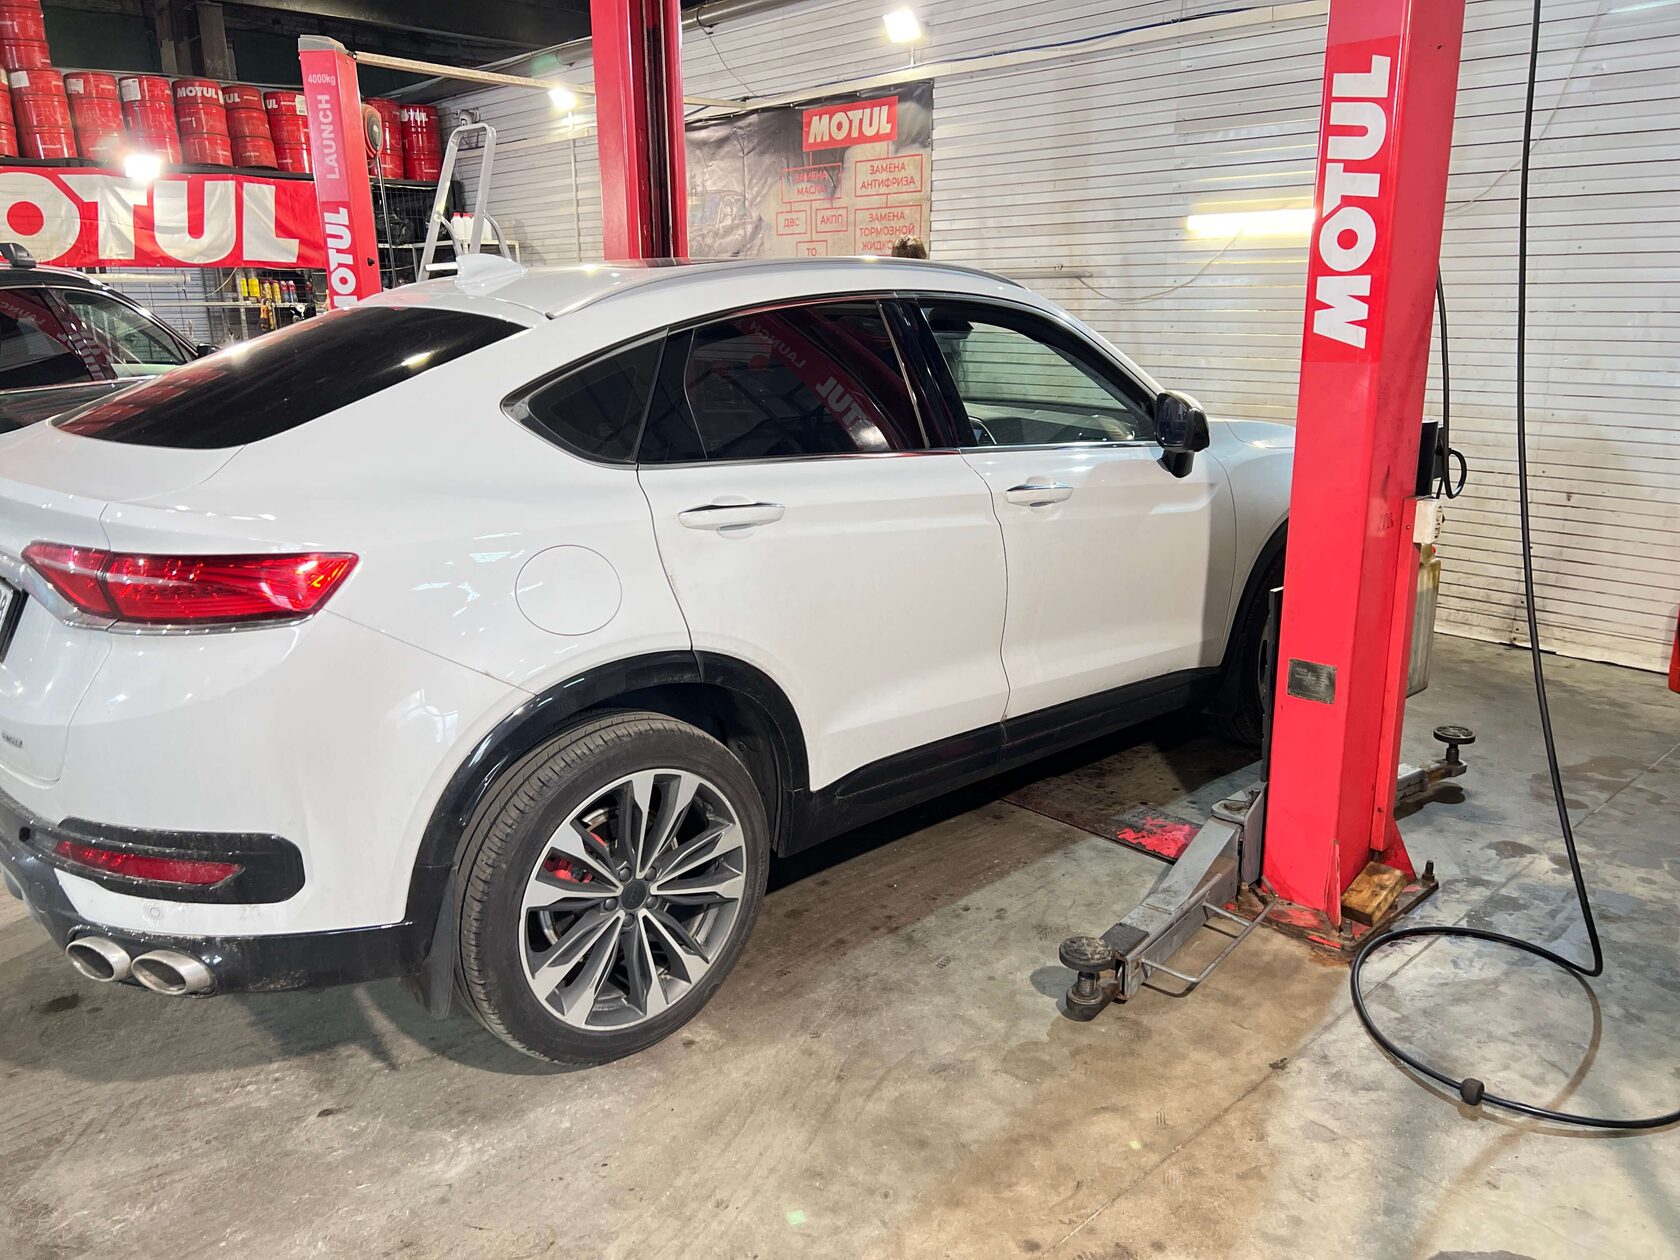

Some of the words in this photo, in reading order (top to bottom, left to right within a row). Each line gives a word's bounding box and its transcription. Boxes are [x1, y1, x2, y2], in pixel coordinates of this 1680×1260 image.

[307, 74, 336, 86] 4000kg
[176, 86, 217, 99] MOTUL
[807, 105, 892, 144] MOTUL
[316, 95, 340, 179] LAUNCH
[869, 162, 906, 175] ЗАМЕНА
[795, 170, 828, 183] ЗАМЕНА
[860, 176, 916, 190] АНТИФРИЗА
[796, 185, 828, 196] МАСЛА
[1312, 54, 1391, 350] MOTUL
[784, 217, 800, 228] ДВС
[820, 214, 843, 225] АКПП
[868, 211, 906, 223] ЗАМЕНА
[859, 223, 916, 237] ТОРМОЗНОЙ
[861, 239, 893, 251] ЖИДКО
[806, 247, 818, 257] ТО
